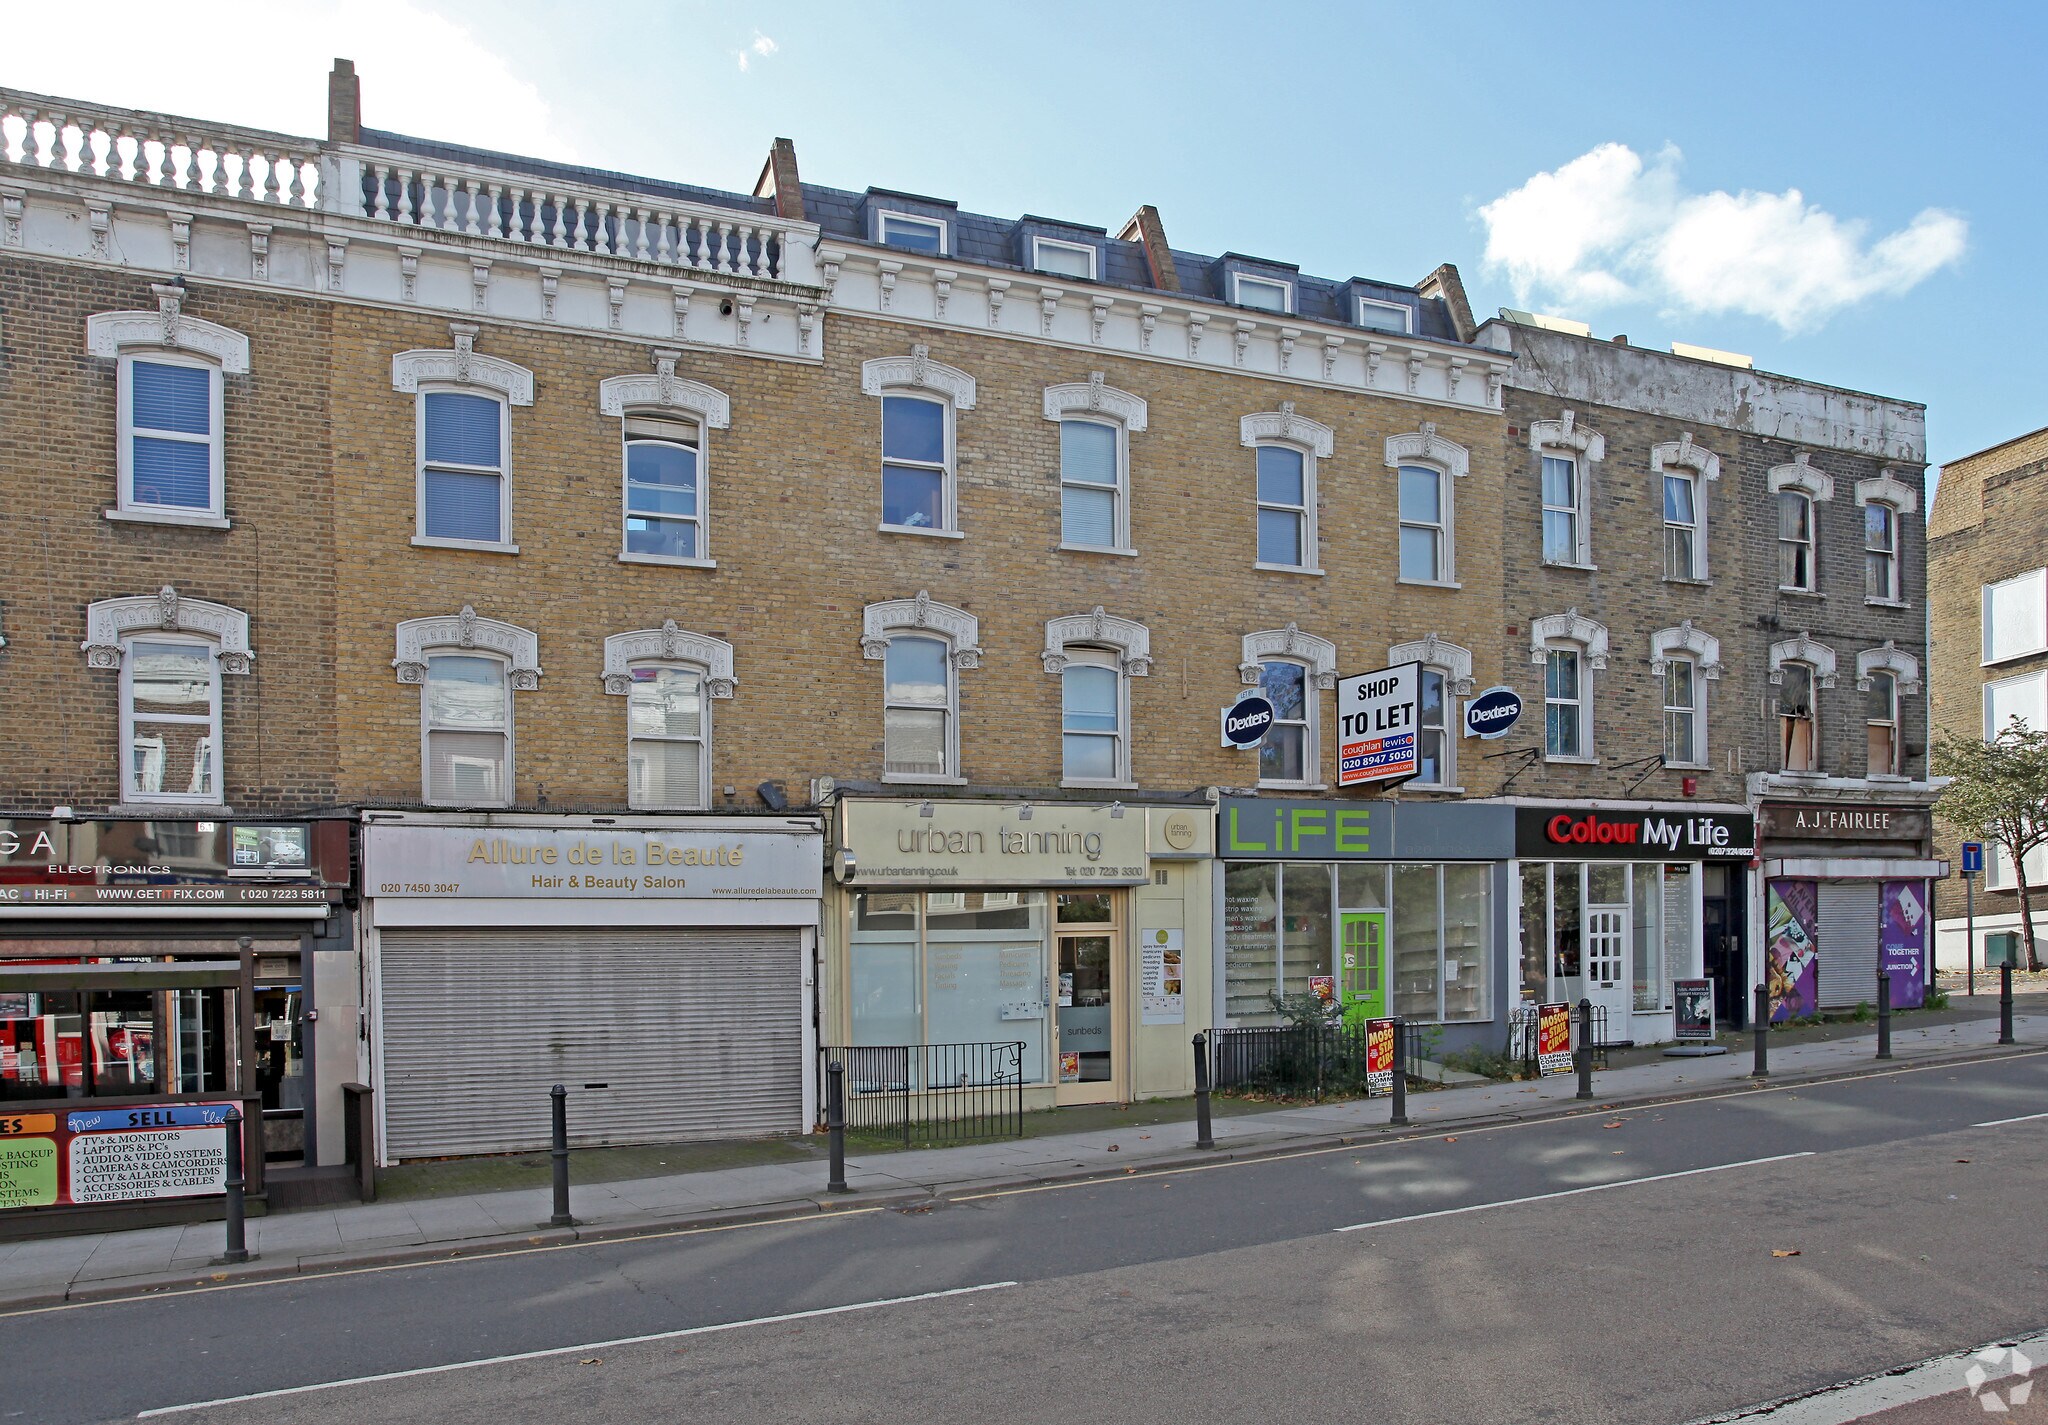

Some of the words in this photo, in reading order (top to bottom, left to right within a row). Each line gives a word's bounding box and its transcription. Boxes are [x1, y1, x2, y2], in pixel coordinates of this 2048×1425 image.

[1358, 676, 1399, 700] SHOP
[1228, 710, 1270, 733] Dexters
[1342, 711, 1368, 737] TO
[1376, 702, 1414, 731] LET
[1471, 703, 1518, 724] Dexters
[1343, 742, 1381, 756] coughlan
[1382, 736, 1405, 748] lewis
[1343, 759, 1360, 769] 020
[1362, 756, 1385, 767] 8947
[1388, 750, 1412, 763] 5050
[1343, 762, 1413, 780] www.coughlanlewis.com
[199, 822, 212, 831] 6.1
[1171, 823, 1188, 831] urban
[1830, 812, 1890, 829] FAIRLEE
[1171, 829, 1192, 838] tanning
[1229, 807, 1370, 852] LiFE
[1547, 814, 1639, 844] Colour
[1642, 817, 1682, 851] My
[1687, 818, 1730, 846] Life
[898, 822, 984, 854] urban
[999, 823, 1102, 861] tanning
[467, 838, 558, 865] Allure
[568, 838, 603, 865] de
[612, 841, 636, 865] la
[646, 840, 744, 866] Beauté
[48, 864, 171, 874] ELECTRONICS
[1080, 866, 1095, 876] 020
[1121, 867, 1143, 876] 3300
[381, 883, 400, 893] 020
[404, 883, 431, 893] 7450
[434, 883, 459, 893] 3047
[532, 874, 563, 888] Hair
[568, 875, 579, 888] &
[585, 875, 638, 891] Beauty
[643, 875, 686, 888] Salon
[712, 886, 817, 895] www.alluredelabeaute.com
[34, 888, 68, 900] Hi-Fi
[97, 889, 225, 899] WWW.GETITFIX.COM
[248, 889, 268, 899] 020
[272, 889, 297, 899] 7223
[301, 890, 326, 899] 5811
[1889, 948, 1919, 956] TOGETHER
[1541, 1010, 1568, 1030] MOSCOW
[1067, 1026, 1102, 1036] sunbeds
[1369, 1027, 1394, 1046] MOSC
[1549, 1021, 1566, 1039] STATE
[1379, 1039, 1394, 1056] STA
[1547, 1030, 1568, 1052] CIRCUS
[1377, 1050, 1394, 1070] CIRC
[1540, 1052, 1570, 1060] CLAPHAM
[68, 1115, 100, 1134] New
[128, 1111, 176, 1127] SELL
[202, 1109, 226, 1124] Use
[83, 1137, 105, 1146] TV's
[106, 1136, 116, 1144] &
[118, 1132, 180, 1144] MONITORS
[7, 1149, 54, 1159] BACKUP
[83, 1144, 134, 1155] LAPTOPS
[136, 1143, 146, 1151] &
[149, 1142, 169, 1151] PC's
[83, 1154, 121, 1164] AUDIO
[123, 1154, 133, 1162] &
[136, 1151, 171, 1161] VIDEO
[173, 1149, 222, 1158] SYSTEMS
[83, 1163, 138, 1174] CAMERAS
[141, 1162, 150, 1170] &
[152, 1157, 228, 1169] CAMCORDERS
[83, 1173, 115, 1184] CCTV
[117, 1173, 127, 1181] &
[129, 1169, 169, 1180] ALARM
[172, 1167, 220, 1177] SYSTEMS
[83, 1179, 160, 1193] ACCESSORIES
[162, 1179, 171, 1187] &
[173, 1176, 215, 1187] CABLES
[83, 1191, 119, 1202] SPARE
[121, 1189, 156, 1198] PARTS
